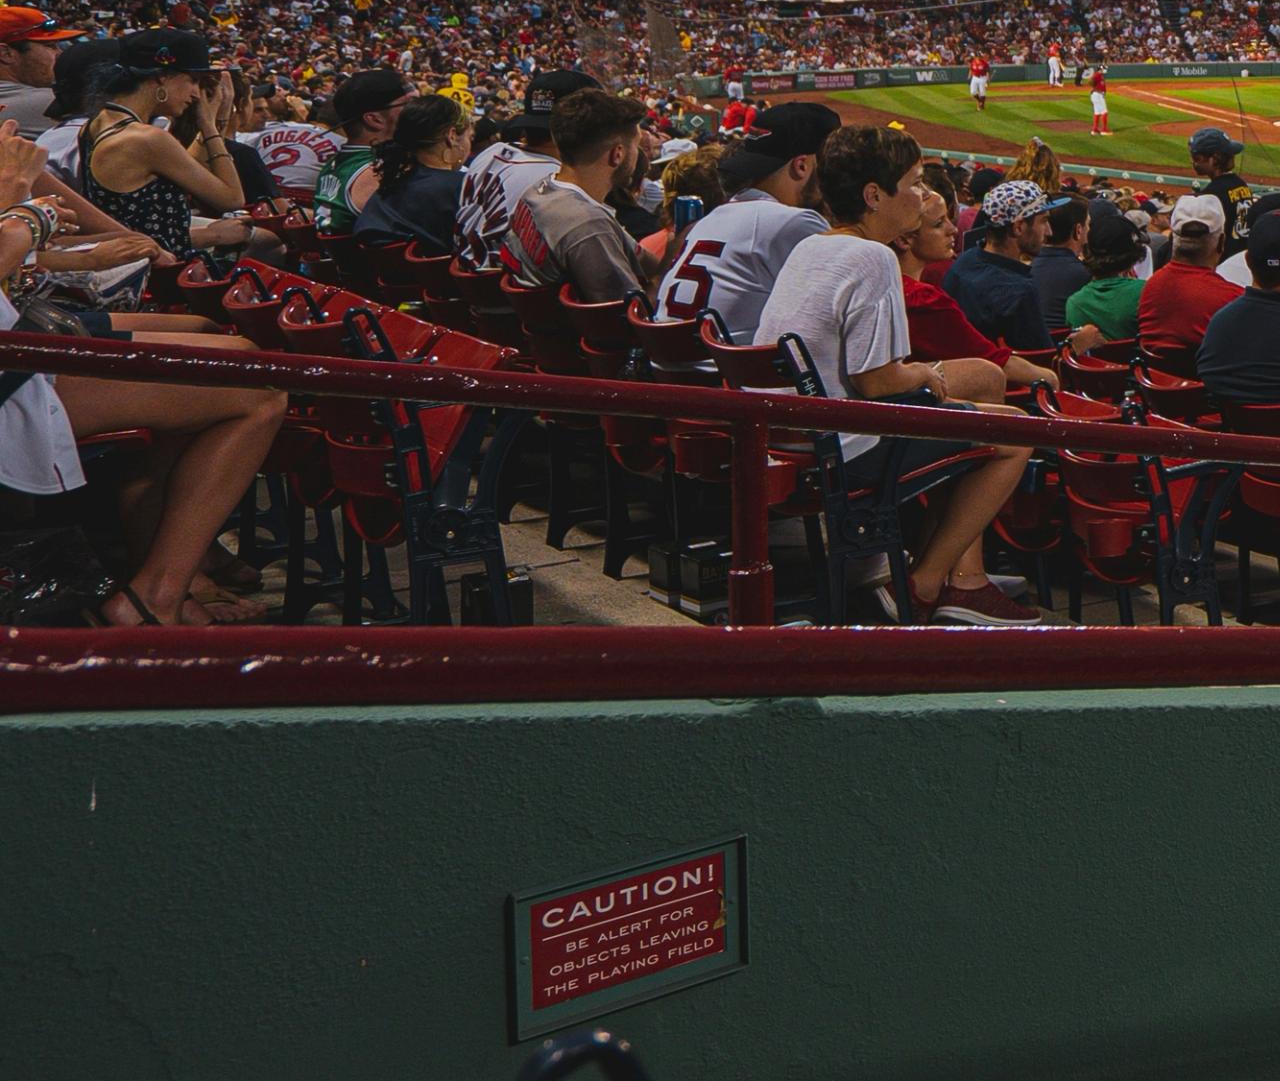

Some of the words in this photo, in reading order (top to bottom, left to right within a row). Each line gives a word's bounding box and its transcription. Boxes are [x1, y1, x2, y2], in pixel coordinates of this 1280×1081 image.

[451, 91, 474, 107] 42
[262, 129, 337, 163] BOGAER
[266, 146, 300, 184] 2
[541, 864, 714, 928] CAUTION!
[549, 945, 631, 976] OBJECTS
[639, 920, 709, 949] LEAVING
[566, 938, 590, 953] BE
[597, 918, 652, 944] ALERT
[660, 906, 695, 925] FOR
[544, 978, 579, 997] THE
[588, 954, 660, 984] PLAYING
[668, 937, 714, 959] FIELD
